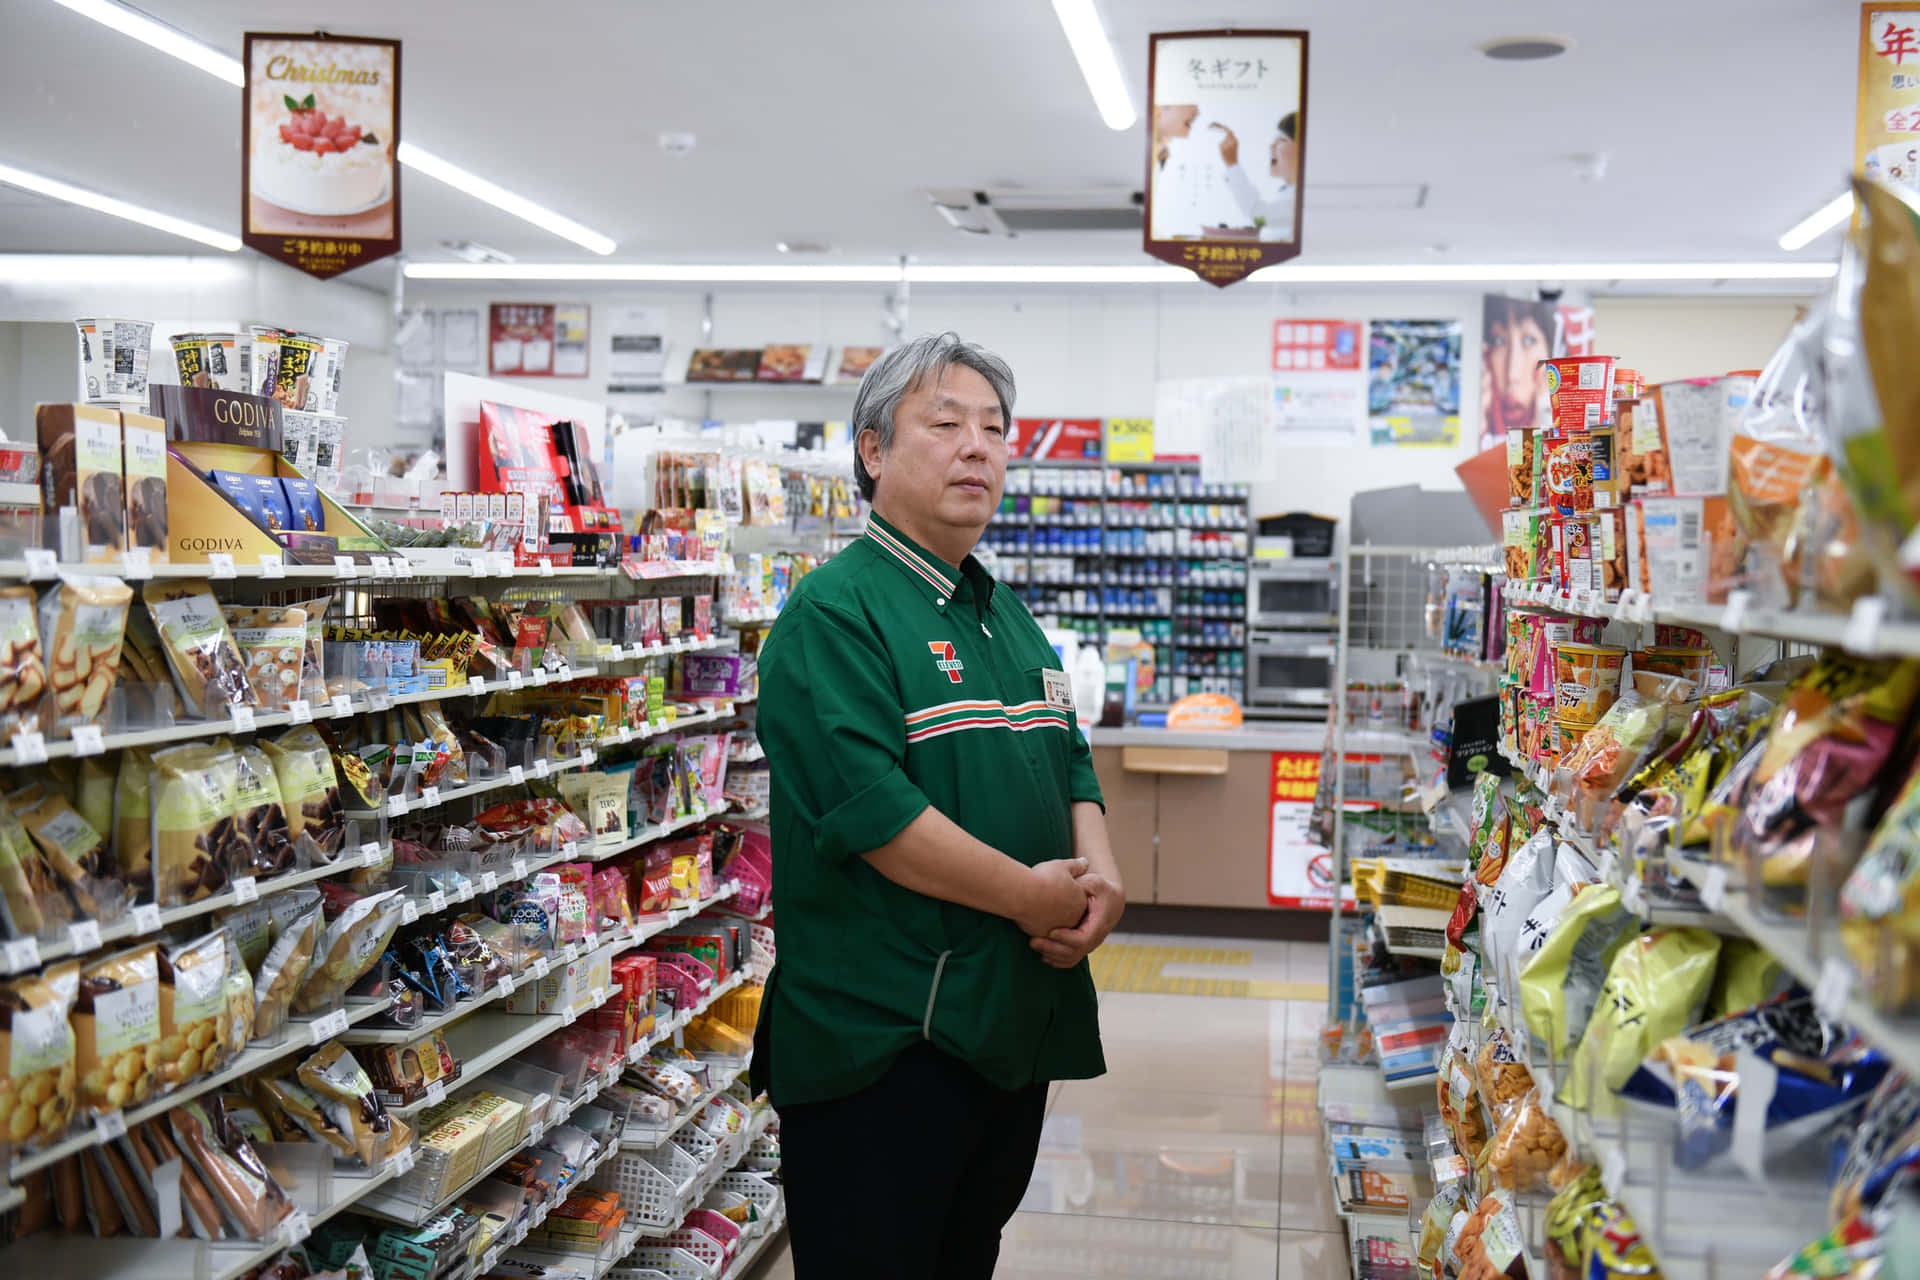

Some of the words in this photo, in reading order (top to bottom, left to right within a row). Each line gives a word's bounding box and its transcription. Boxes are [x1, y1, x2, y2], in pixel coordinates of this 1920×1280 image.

[1875, 22, 1920, 67] 年
[265, 55, 380, 85] Christmas
[1188, 58, 1269, 80] 冬ギフト
[283, 239, 362, 256] ご予約承り中
[294, 349, 309, 374] 神田
[279, 356, 296, 391] まつや
[214, 398, 276, 430] GODIVA
[179, 537, 244, 550] GODIVA
[600, 799, 616, 809] ZERO
[510, 909, 540, 918] LOOK
[430, 1120, 467, 1142] meiji
[502, 1258, 546, 1271] DARS
